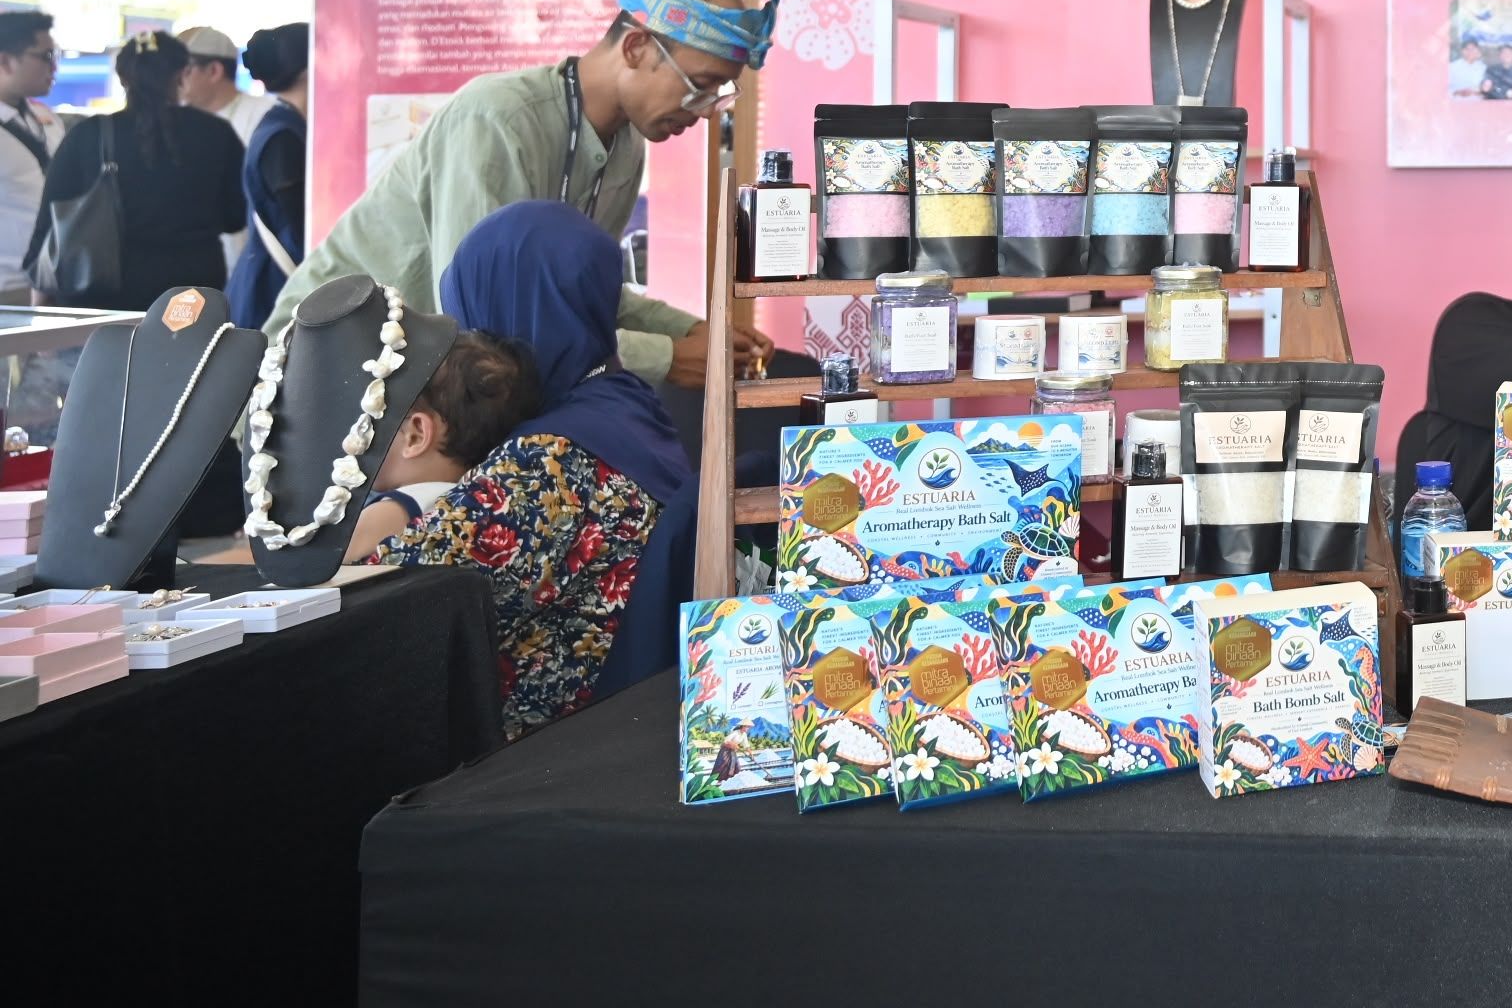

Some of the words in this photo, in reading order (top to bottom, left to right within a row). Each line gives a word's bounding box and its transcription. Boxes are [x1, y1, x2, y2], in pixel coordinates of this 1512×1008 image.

[1209, 435, 1272, 445] ESTUARIA
[903, 490, 976, 506] ESTUARIA
[1136, 506, 1172, 514] ESTUARIA
[862, 517, 955, 534] Aromatherapy
[958, 514, 986, 526] Bath
[989, 511, 1011, 523] Salt
[1422, 643, 1456, 652] ESTUARIA
[1124, 651, 1193, 672] ESTUARIA
[1442, 660, 1453, 669] Body
[735, 667, 763, 675] ESTUARIA
[824, 670, 853, 682] mitra
[921, 668, 949, 681] mitra
[1042, 672, 1069, 685] mitra
[1266, 670, 1331, 688] ESTUARIA
[1094, 678, 1180, 704] Aromatherapy
[1183, 675, 1197, 688] Ba
[1253, 699, 1282, 713] Bath
[1285, 695, 1321, 709] Bomb
[1323, 690, 1345, 705] Salt
